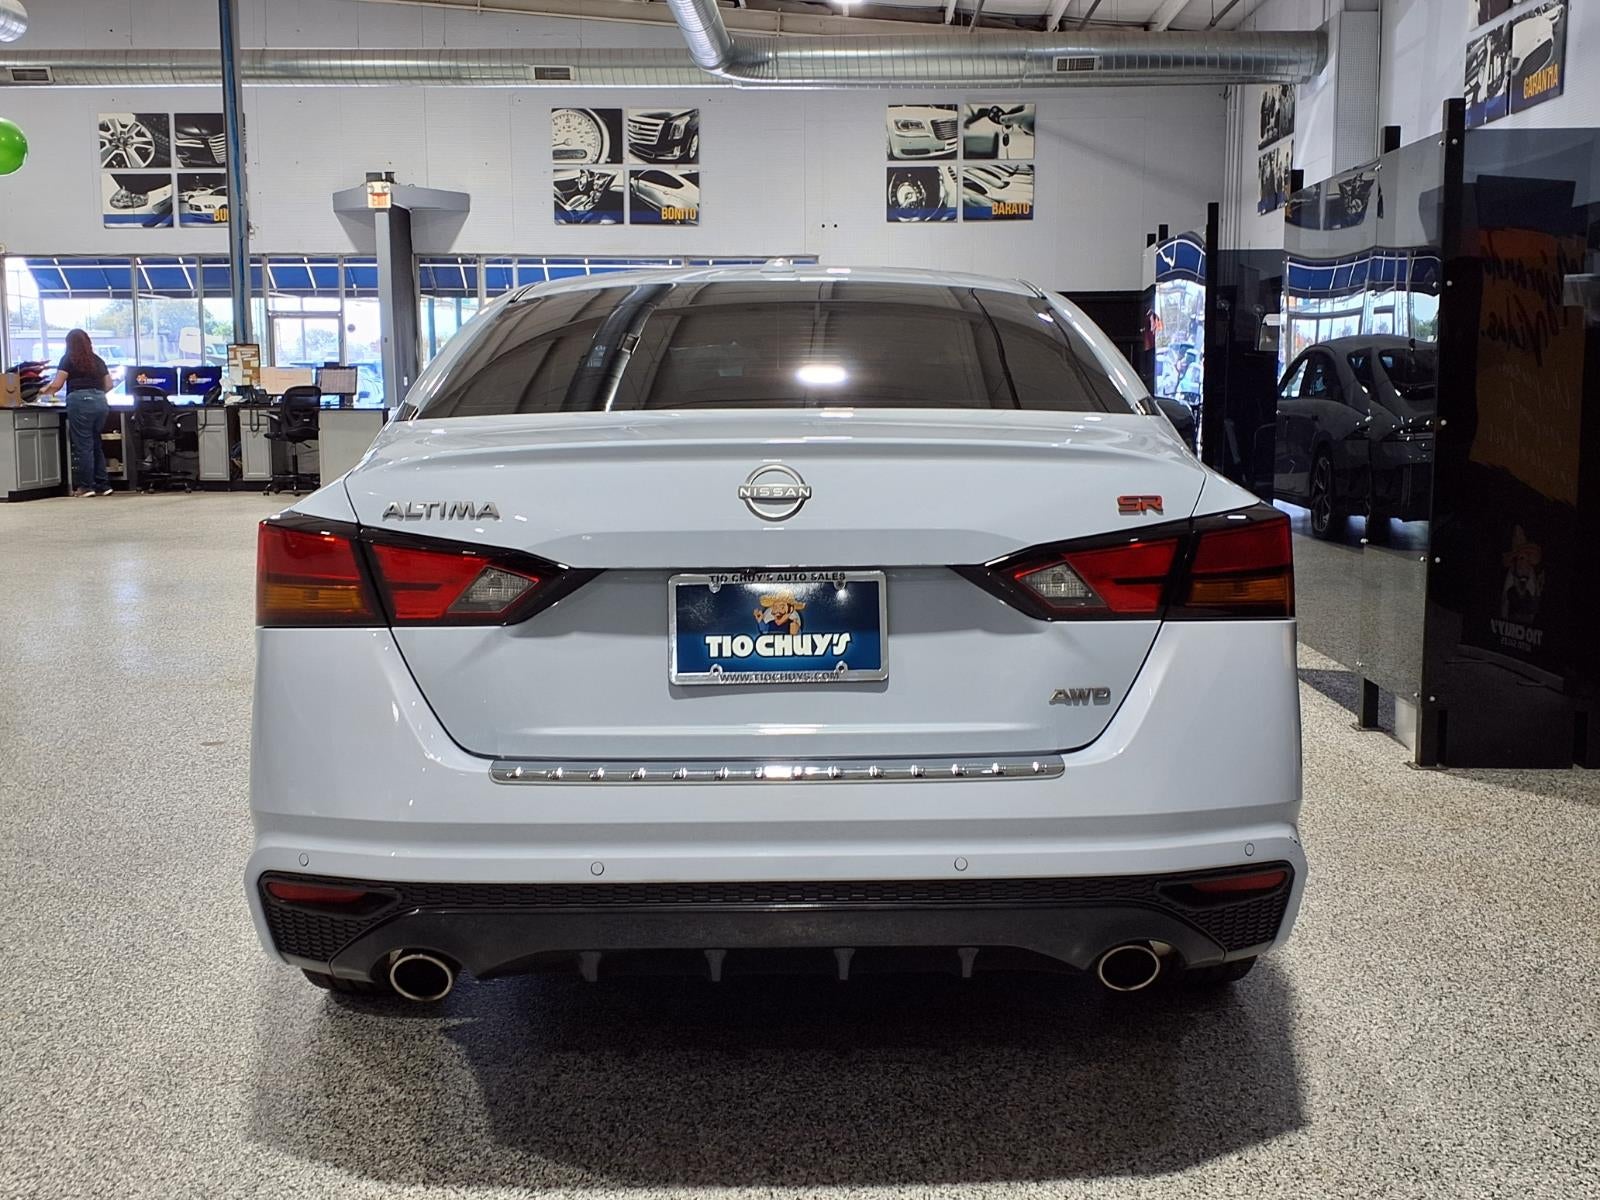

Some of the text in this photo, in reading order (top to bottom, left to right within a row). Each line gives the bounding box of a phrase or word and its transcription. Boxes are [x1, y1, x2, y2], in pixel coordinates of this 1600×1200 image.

[661, 207, 697, 221] BONITO
[992, 202, 1030, 216] BARATO
[739, 487, 811, 498] NISSAN
[381, 501, 501, 521] ALTIMA
[1117, 495, 1164, 516] SR
[709, 572, 846, 584] TIO CHUY'S AUTO SALES
[705, 632, 851, 657] TIO CHUY'S
[719, 672, 840, 684] WWW.TIOCHUYS.COM
[1048, 688, 1111, 706] AWD
